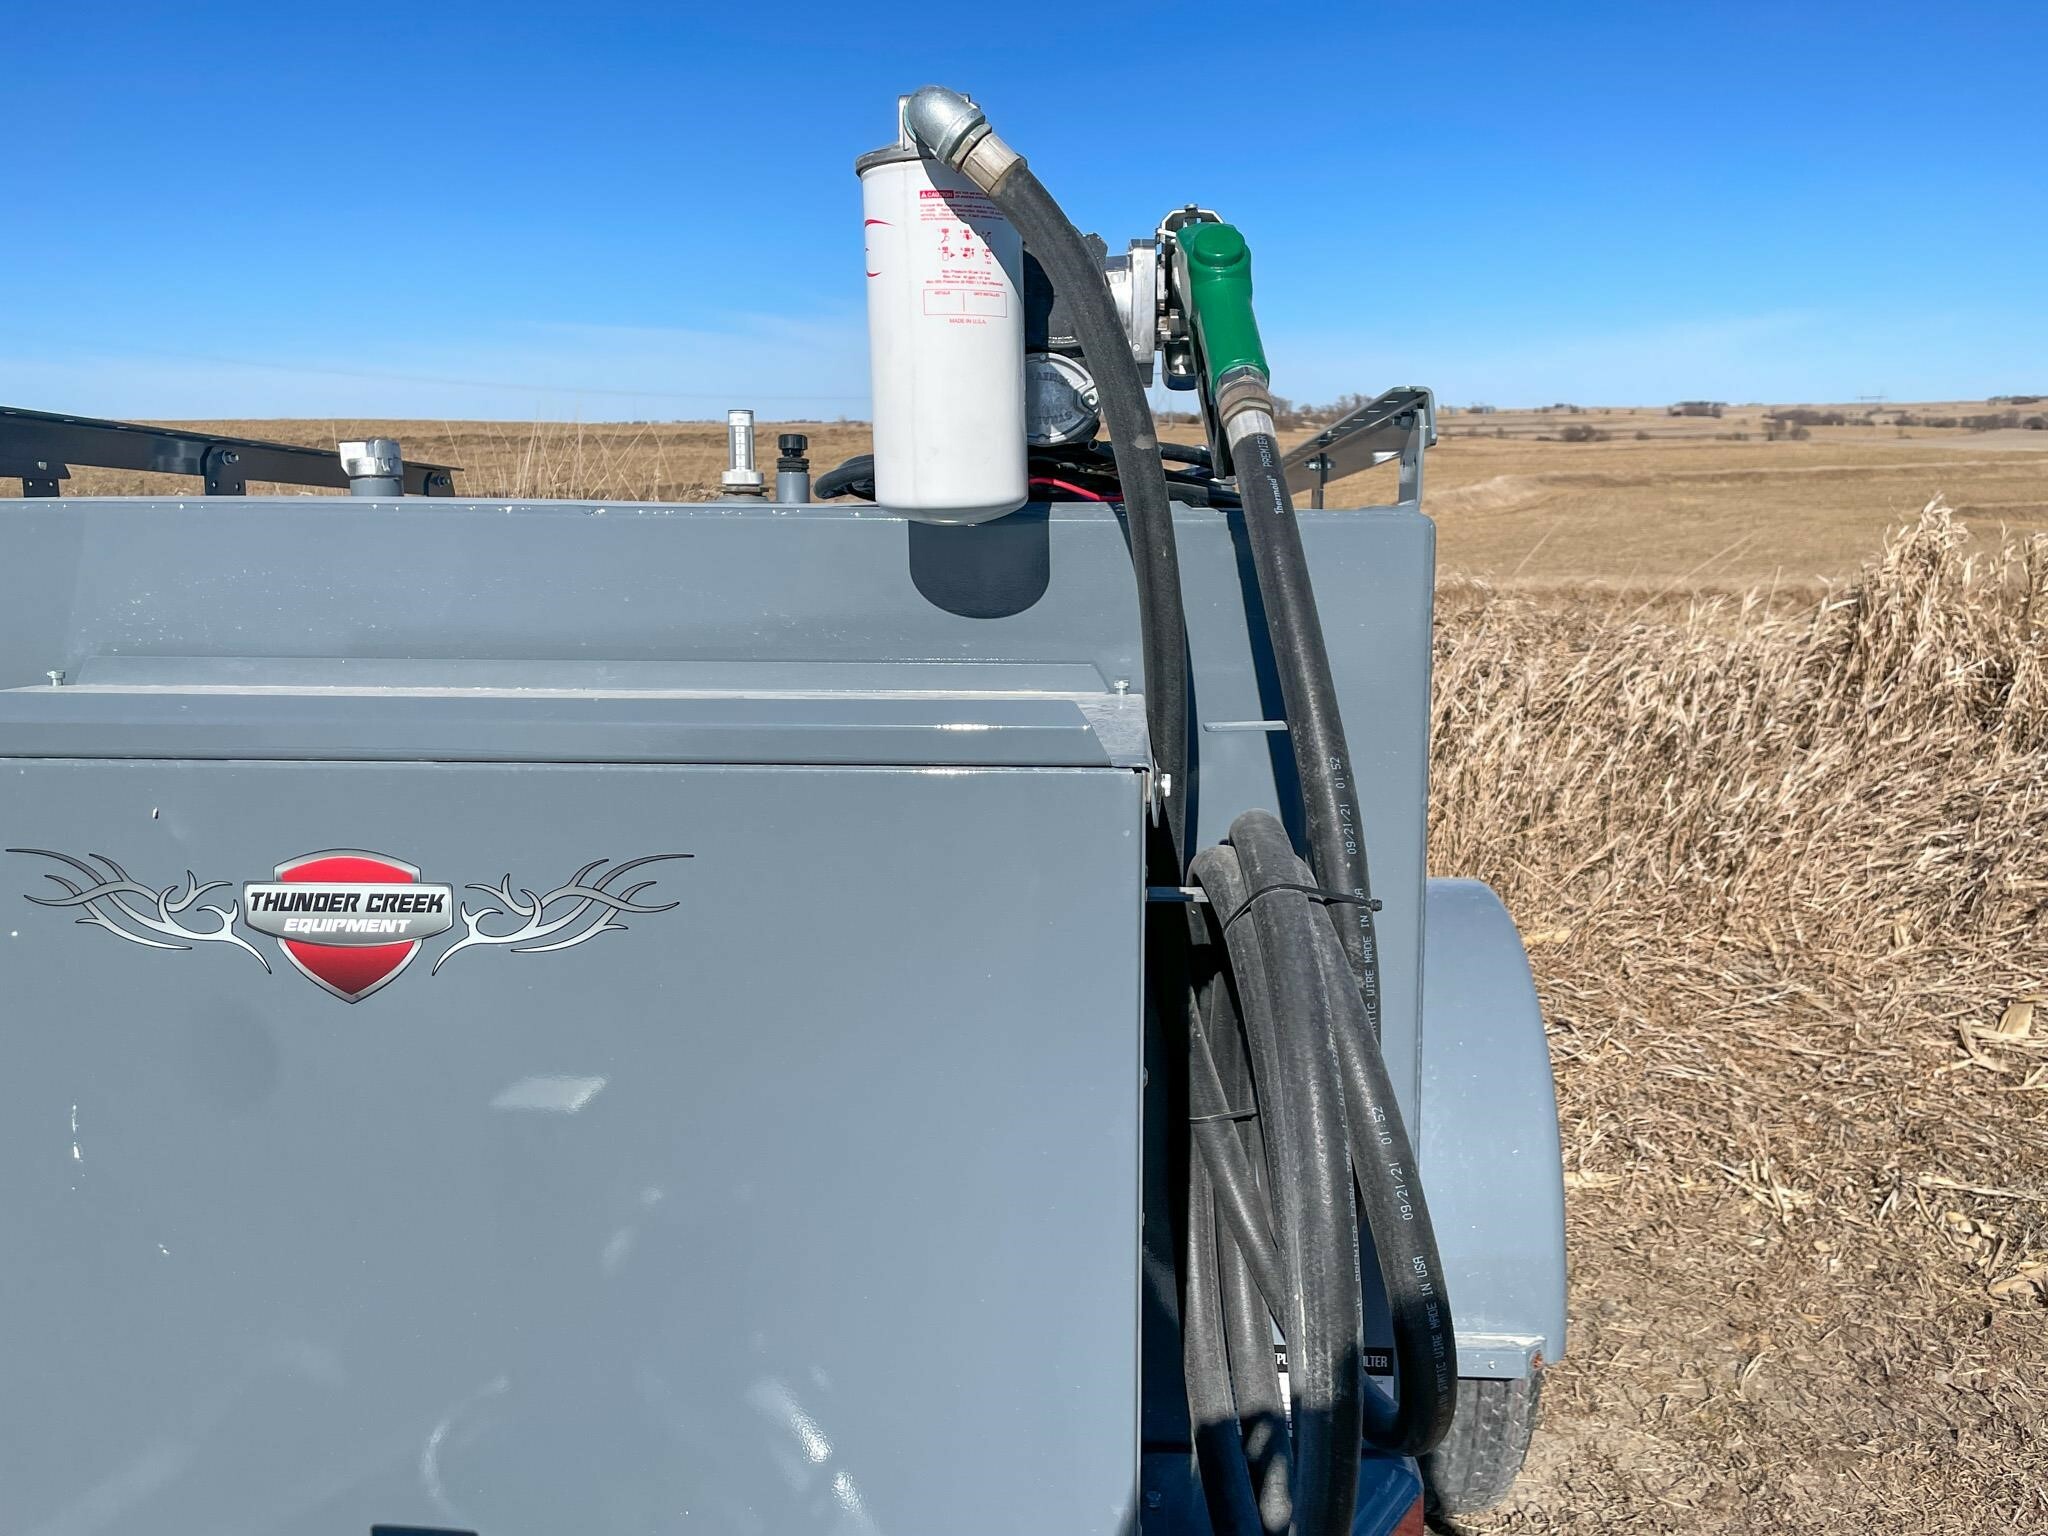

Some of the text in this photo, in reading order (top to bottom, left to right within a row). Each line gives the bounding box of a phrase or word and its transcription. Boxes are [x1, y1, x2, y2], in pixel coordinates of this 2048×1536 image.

[1257, 435, 1273, 468] PREMIER
[1339, 804, 1357, 855] 09/21/21
[250, 892, 446, 914] THUNDER CREEK
[283, 918, 412, 934] EQUIPMENT
[1359, 915, 1370, 928] IN
[1362, 935, 1374, 963] MADE
[1365, 970, 1375, 997] WIRE
[1371, 1105, 1393, 1145] 01:52
[1389, 1162, 1414, 1221] 09/21/21
[1412, 1255, 1428, 1278] USA
[1420, 1282, 1434, 1297] IN
[1426, 1302, 1441, 1330] MADE
[1432, 1334, 1445, 1359] WIRE
[1362, 1355, 1388, 1368] ILTER
